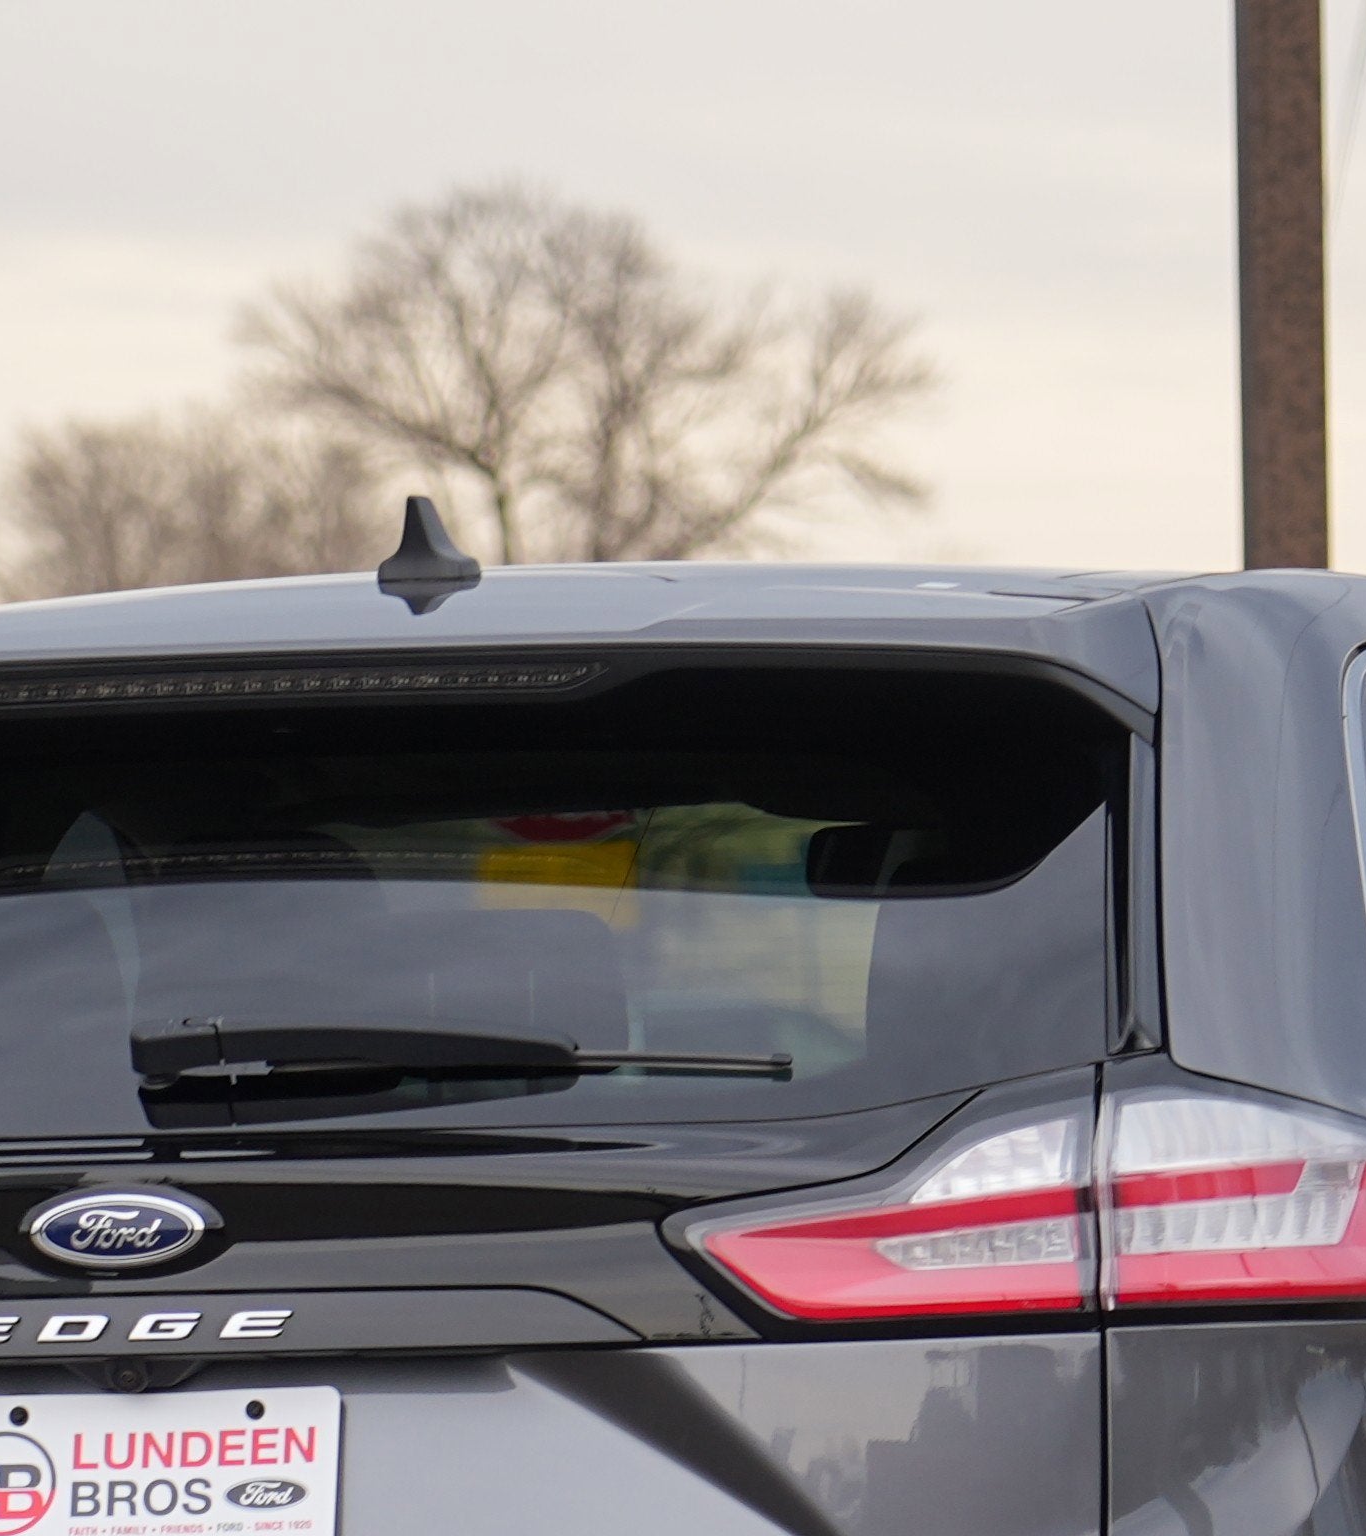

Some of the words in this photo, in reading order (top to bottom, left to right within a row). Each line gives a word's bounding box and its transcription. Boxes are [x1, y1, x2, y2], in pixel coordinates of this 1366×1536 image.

[70, 1209, 163, 1251] Ford
[72, 1426, 317, 1470] LUNDEEN
[70, 1479, 212, 1518] BROS
[239, 1481, 295, 1507] Ford
[68, 1526, 98, 1536] FAITH
[110, 1525, 147, 1536] FAMILY
[160, 1523, 204, 1535] FRIENDS
[216, 1522, 243, 1533] FORD
